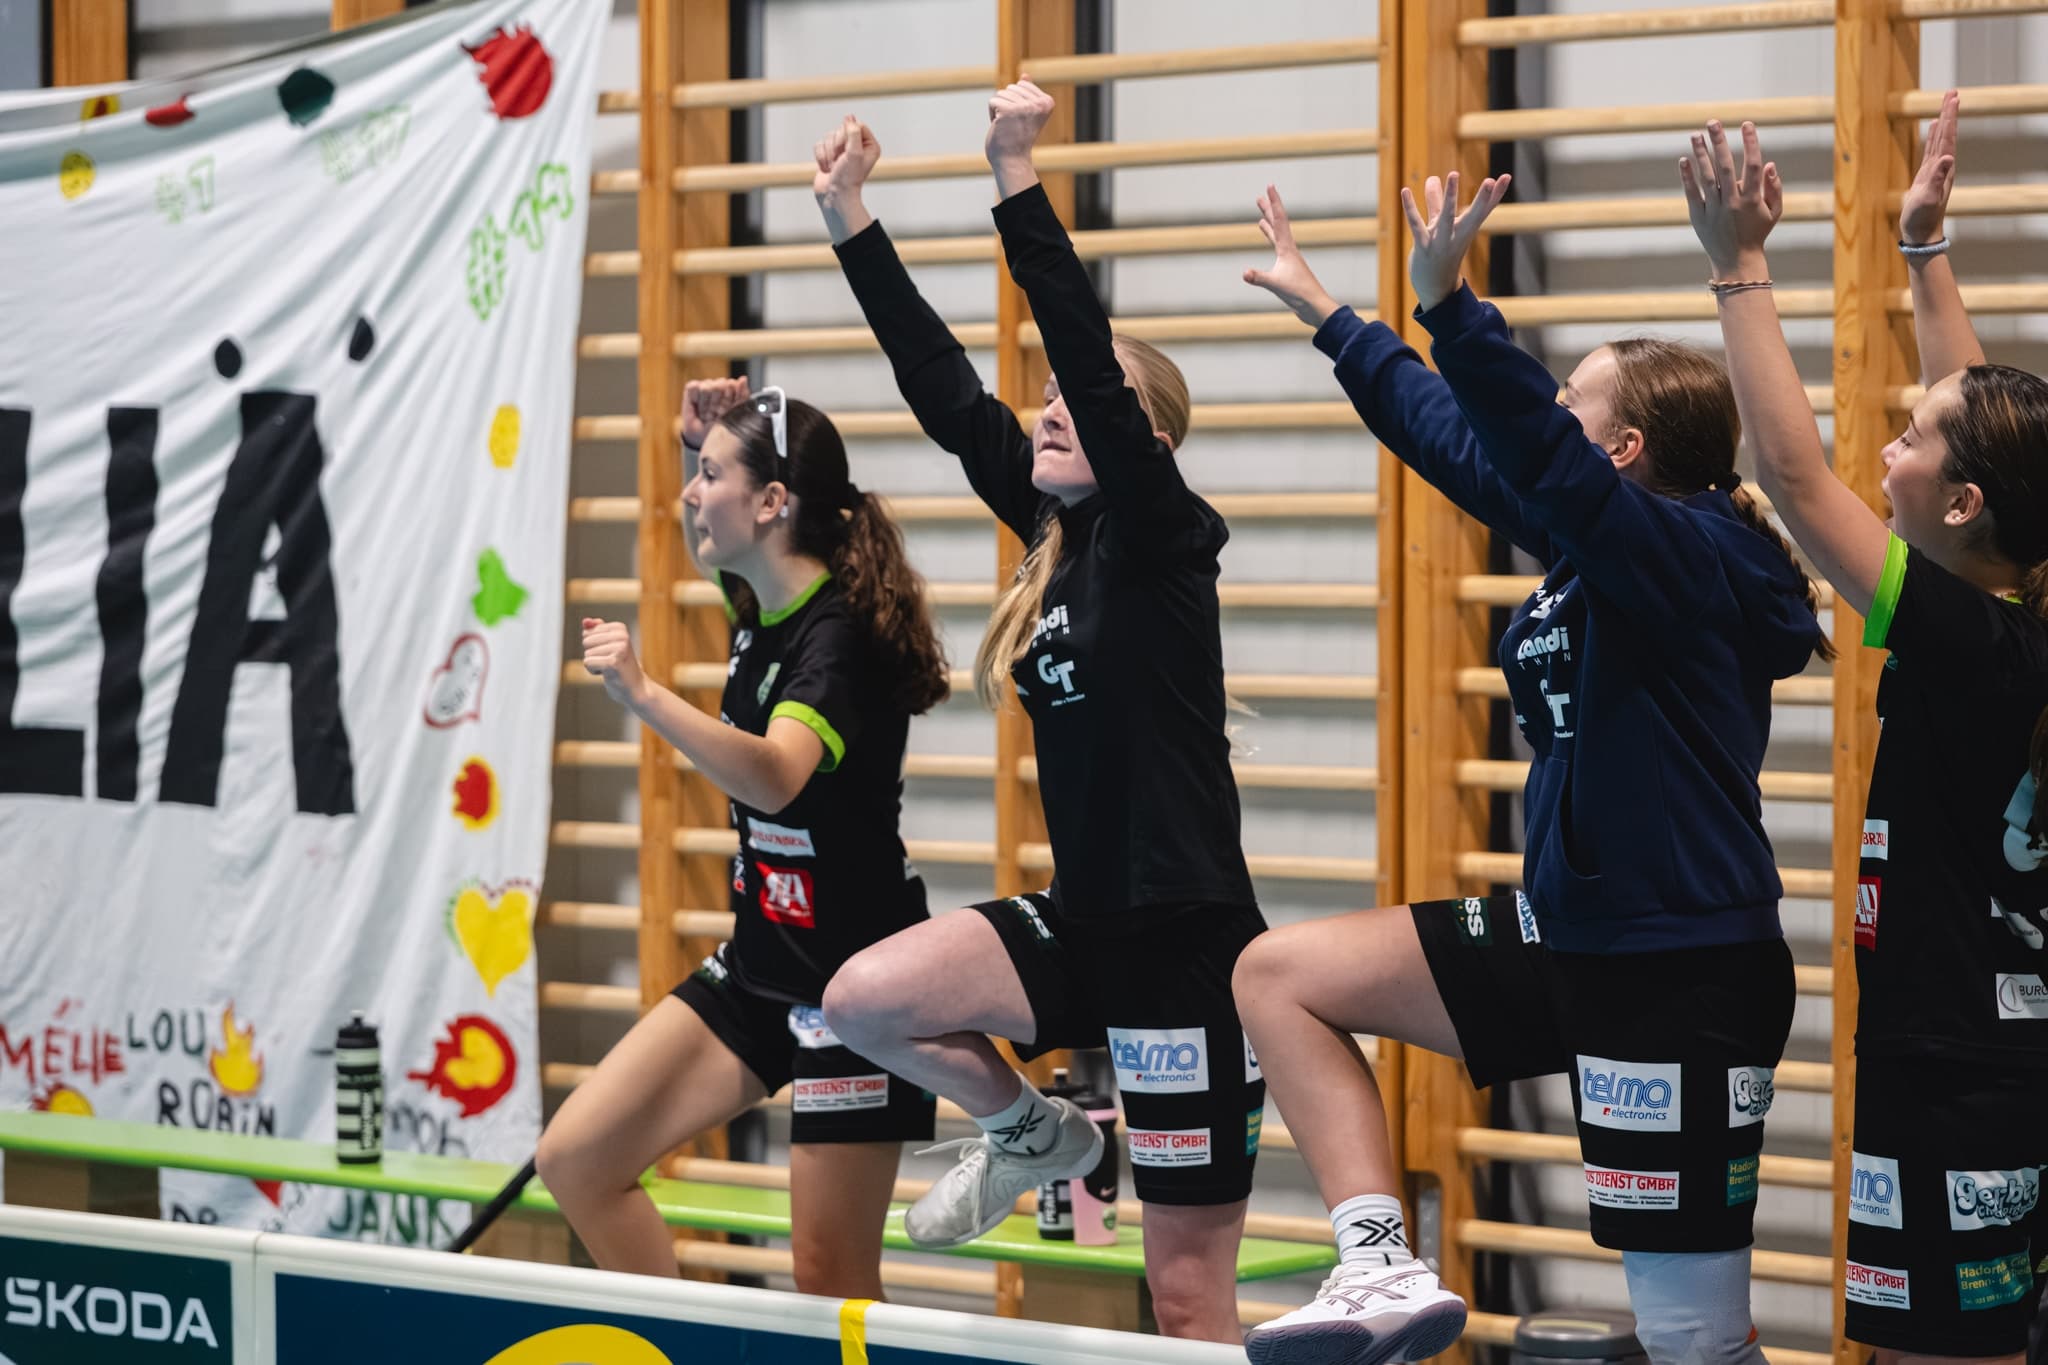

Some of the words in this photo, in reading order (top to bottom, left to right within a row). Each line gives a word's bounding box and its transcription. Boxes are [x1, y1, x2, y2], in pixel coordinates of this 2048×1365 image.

[1032, 605, 1069, 640] ndi
[127, 1009, 205, 1055] LOU
[1113, 1038, 1199, 1071] telma
[1143, 1072, 1196, 1083] electronics
[1584, 1067, 1672, 1109] telma
[1611, 1107, 1668, 1121] electronics
[1133, 1134, 1169, 1149] DIENST
[1172, 1135, 1208, 1149] GMBH
[1595, 1172, 1634, 1190] DIENST
[1636, 1177, 1677, 1191] GMBH
[1852, 1202, 1890, 1217] electronics
[1874, 1271, 1907, 1290] GMBH
